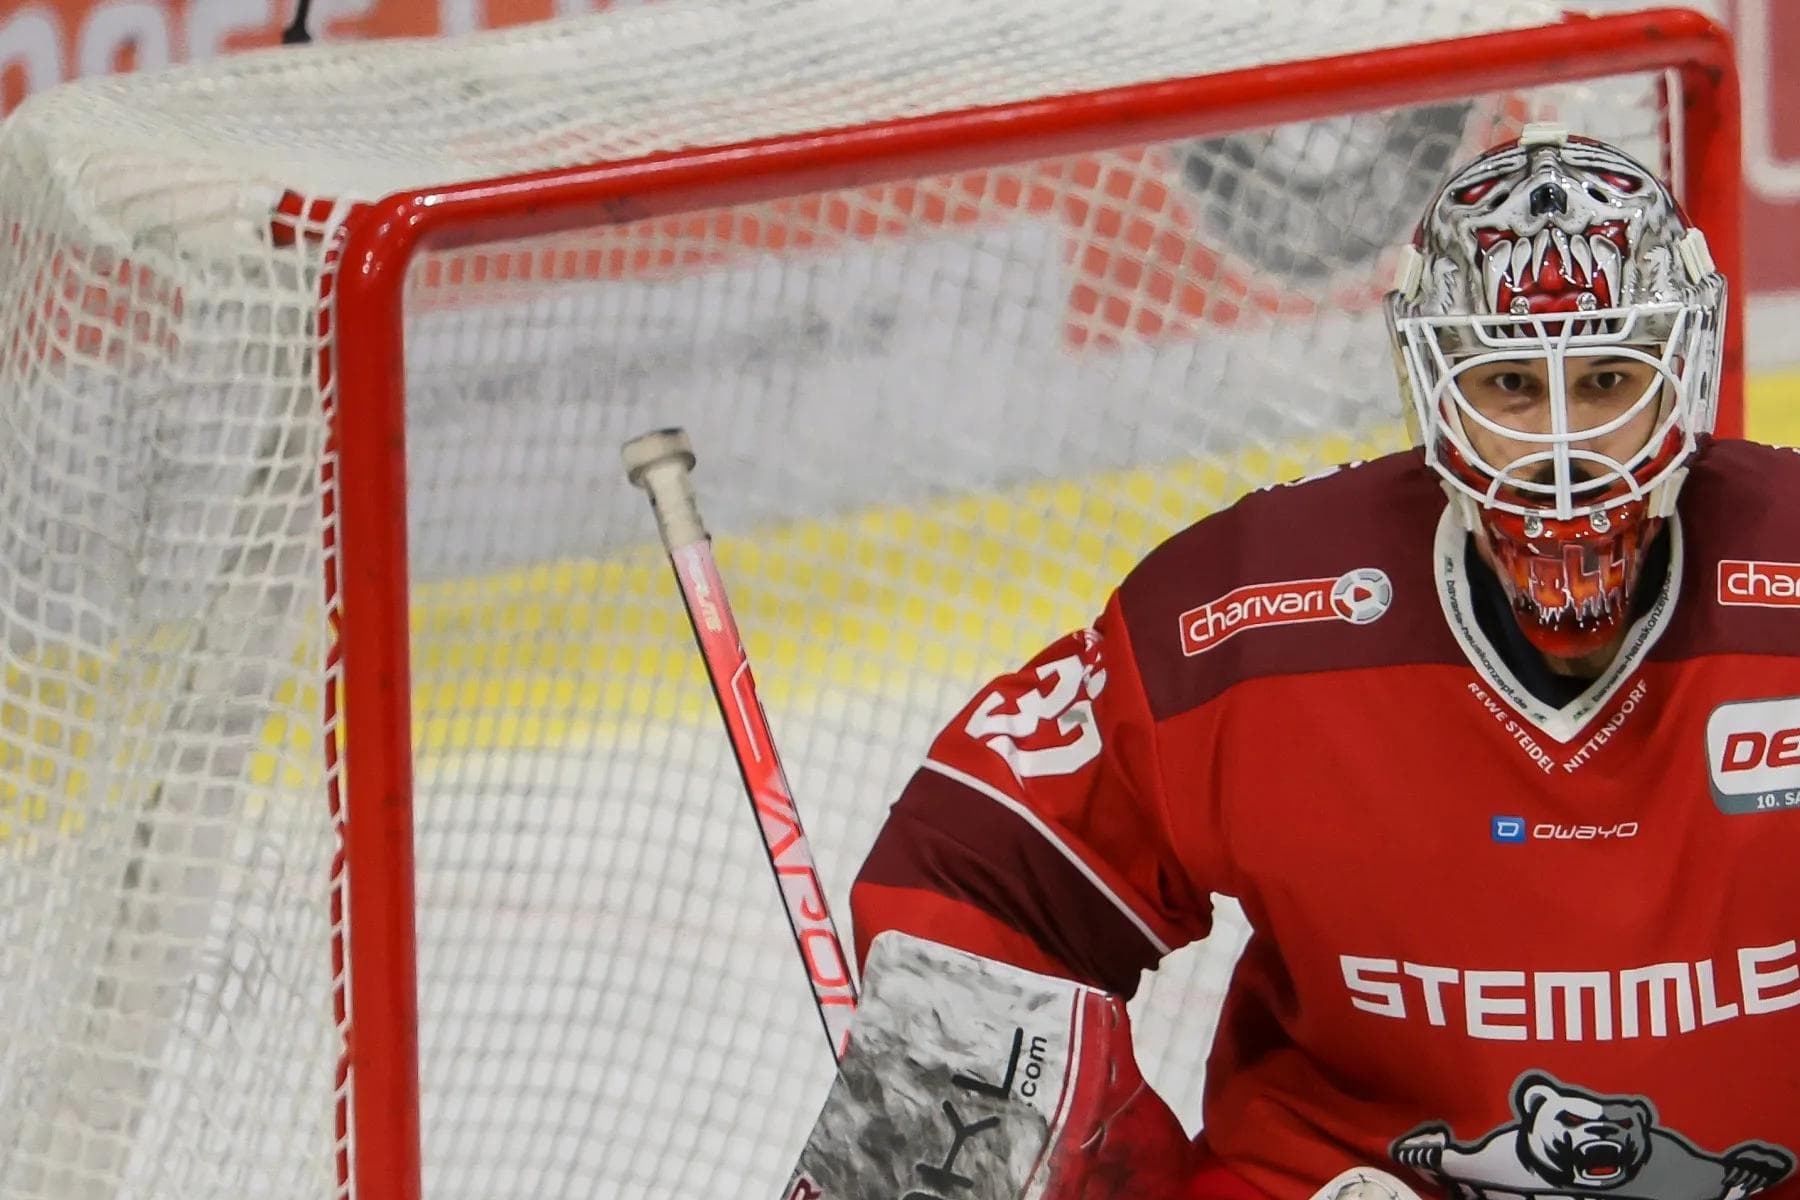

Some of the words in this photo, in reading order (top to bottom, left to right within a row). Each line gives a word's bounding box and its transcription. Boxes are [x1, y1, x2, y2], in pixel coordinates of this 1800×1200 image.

[1188, 588, 1325, 643] charivari
[1467, 681, 1509, 722] REWE
[1505, 719, 1556, 775] STEIDEL
[1562, 678, 1649, 774] NITTENDORF
[1756, 795, 1781, 809] 10.
